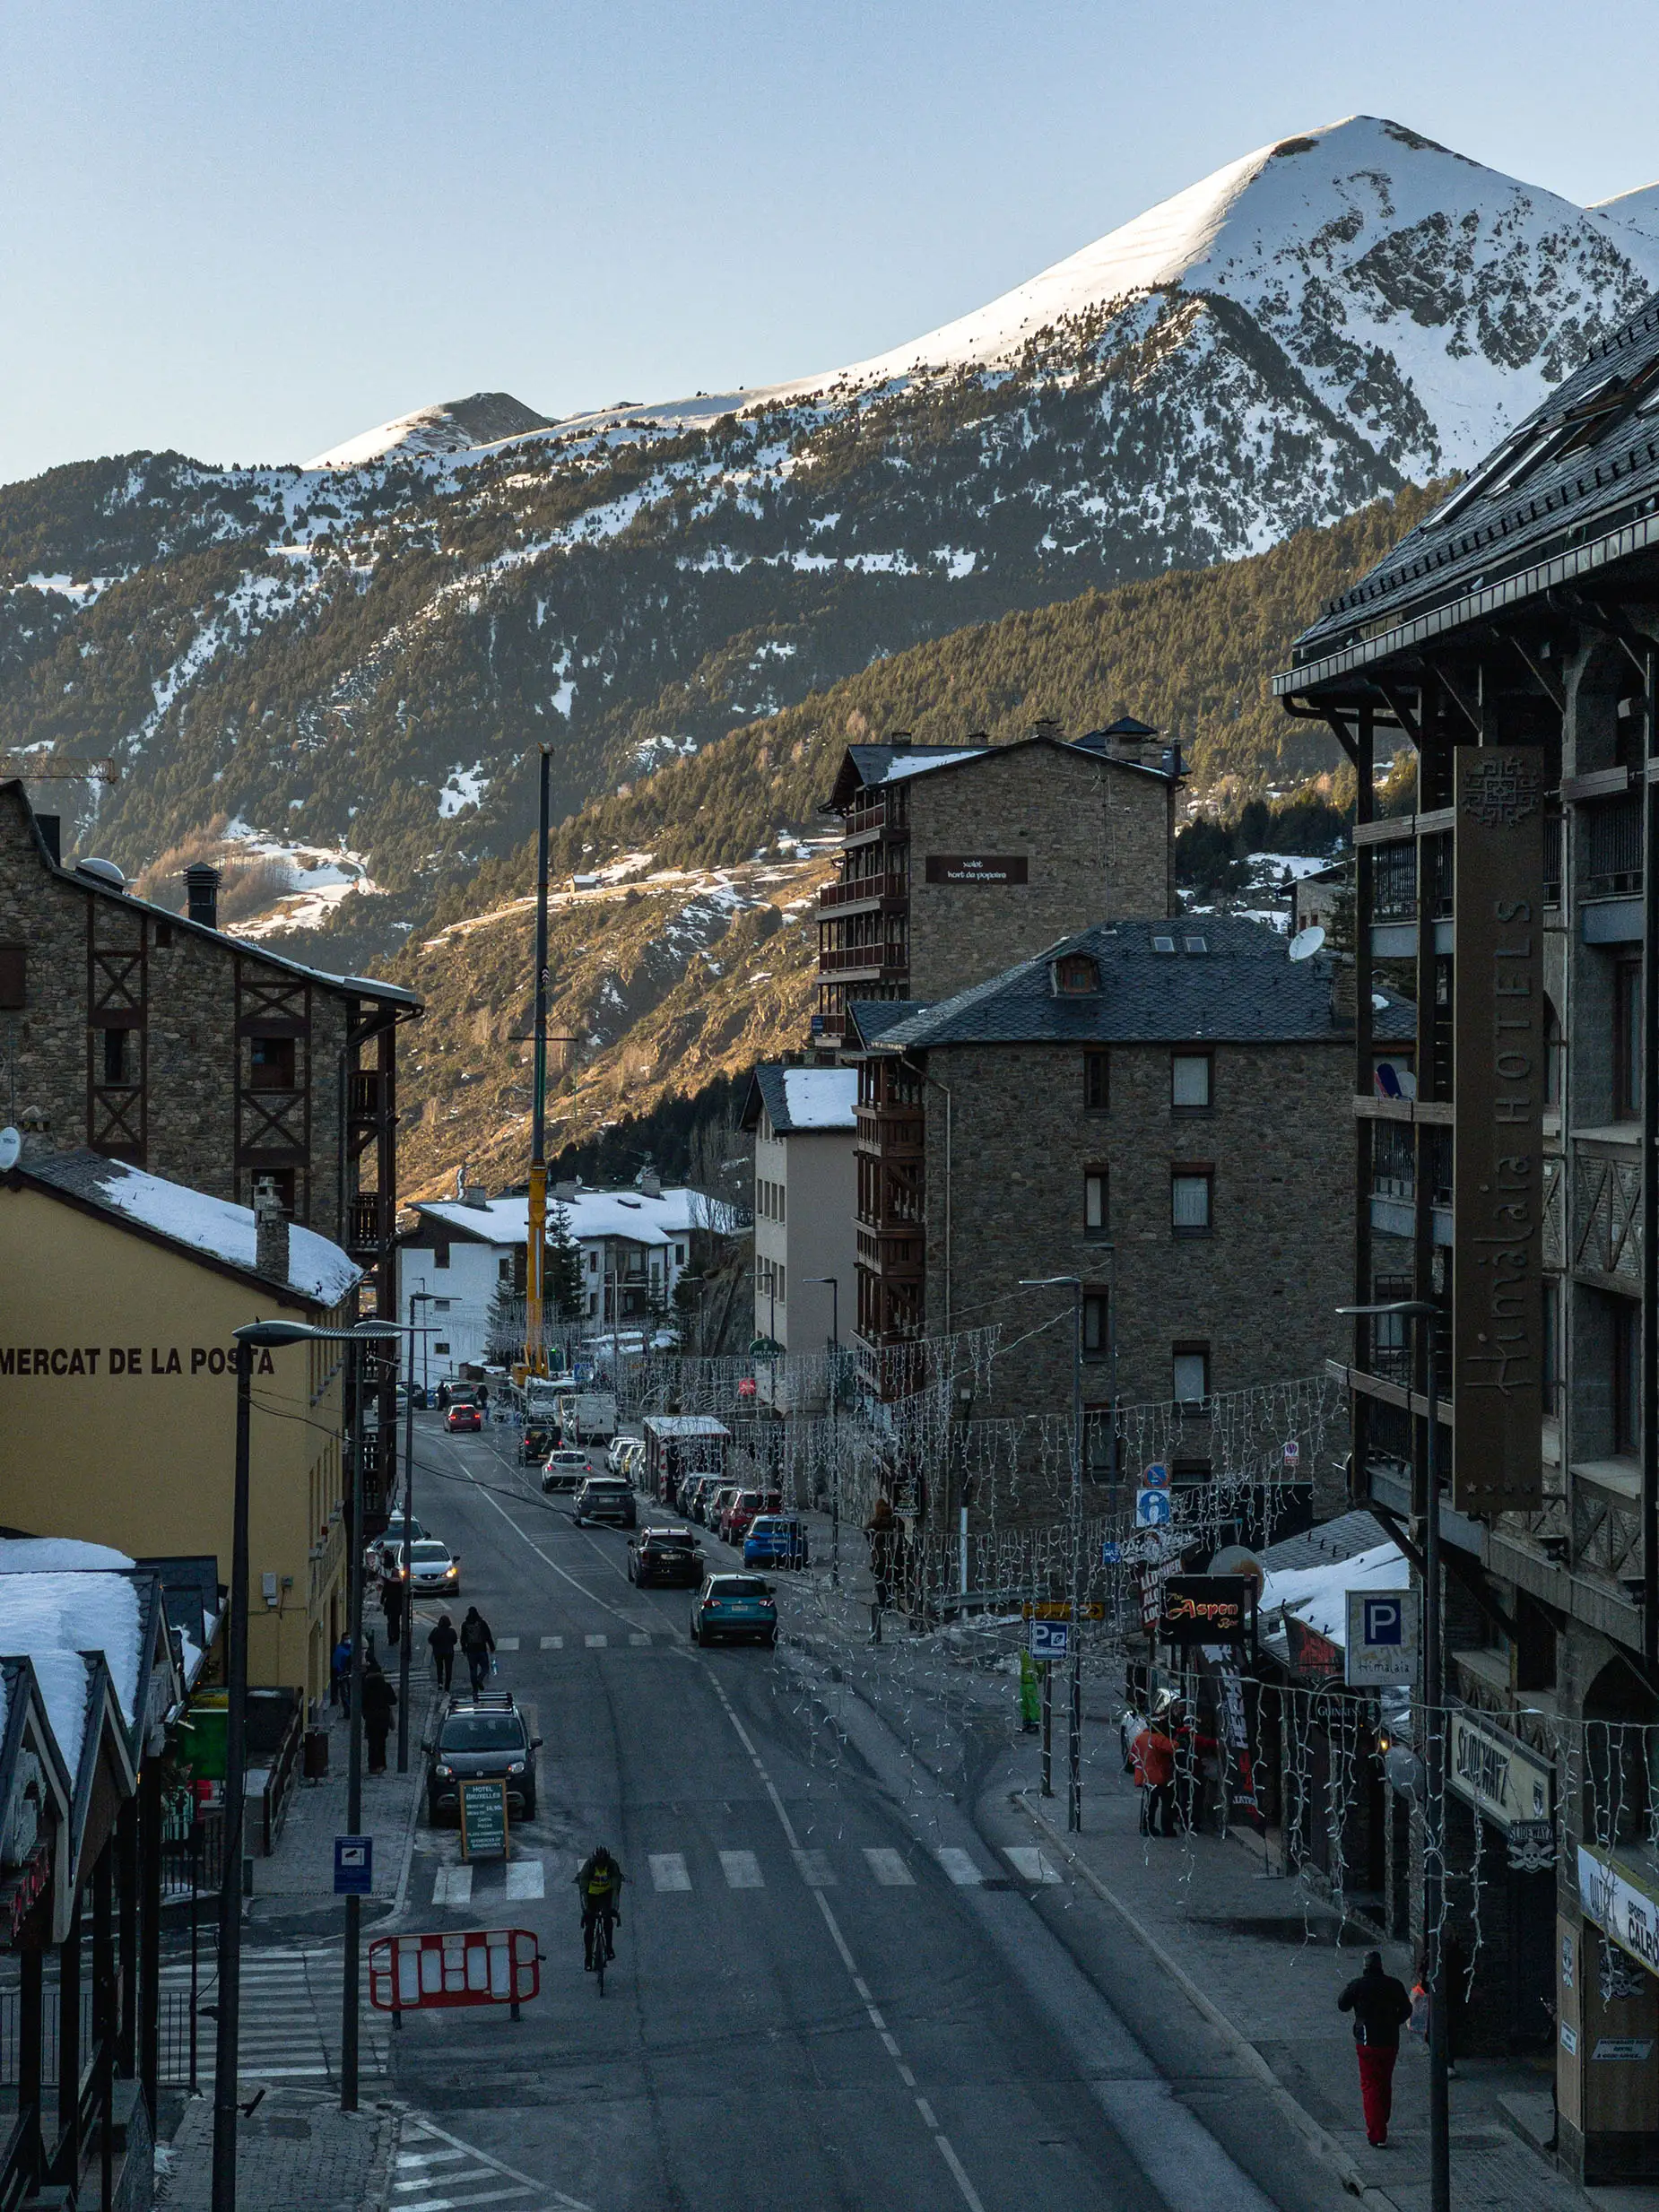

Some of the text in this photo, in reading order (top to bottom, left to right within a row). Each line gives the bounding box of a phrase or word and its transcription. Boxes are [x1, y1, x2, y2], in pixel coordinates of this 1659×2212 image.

[1495, 900, 1532, 1125] HOTELS
[0, 1348, 100, 1375] MERCAT
[109, 1348, 143, 1375] DE
[152, 1348, 182, 1375] LA
[1168, 1599, 1238, 1620] Aspen
